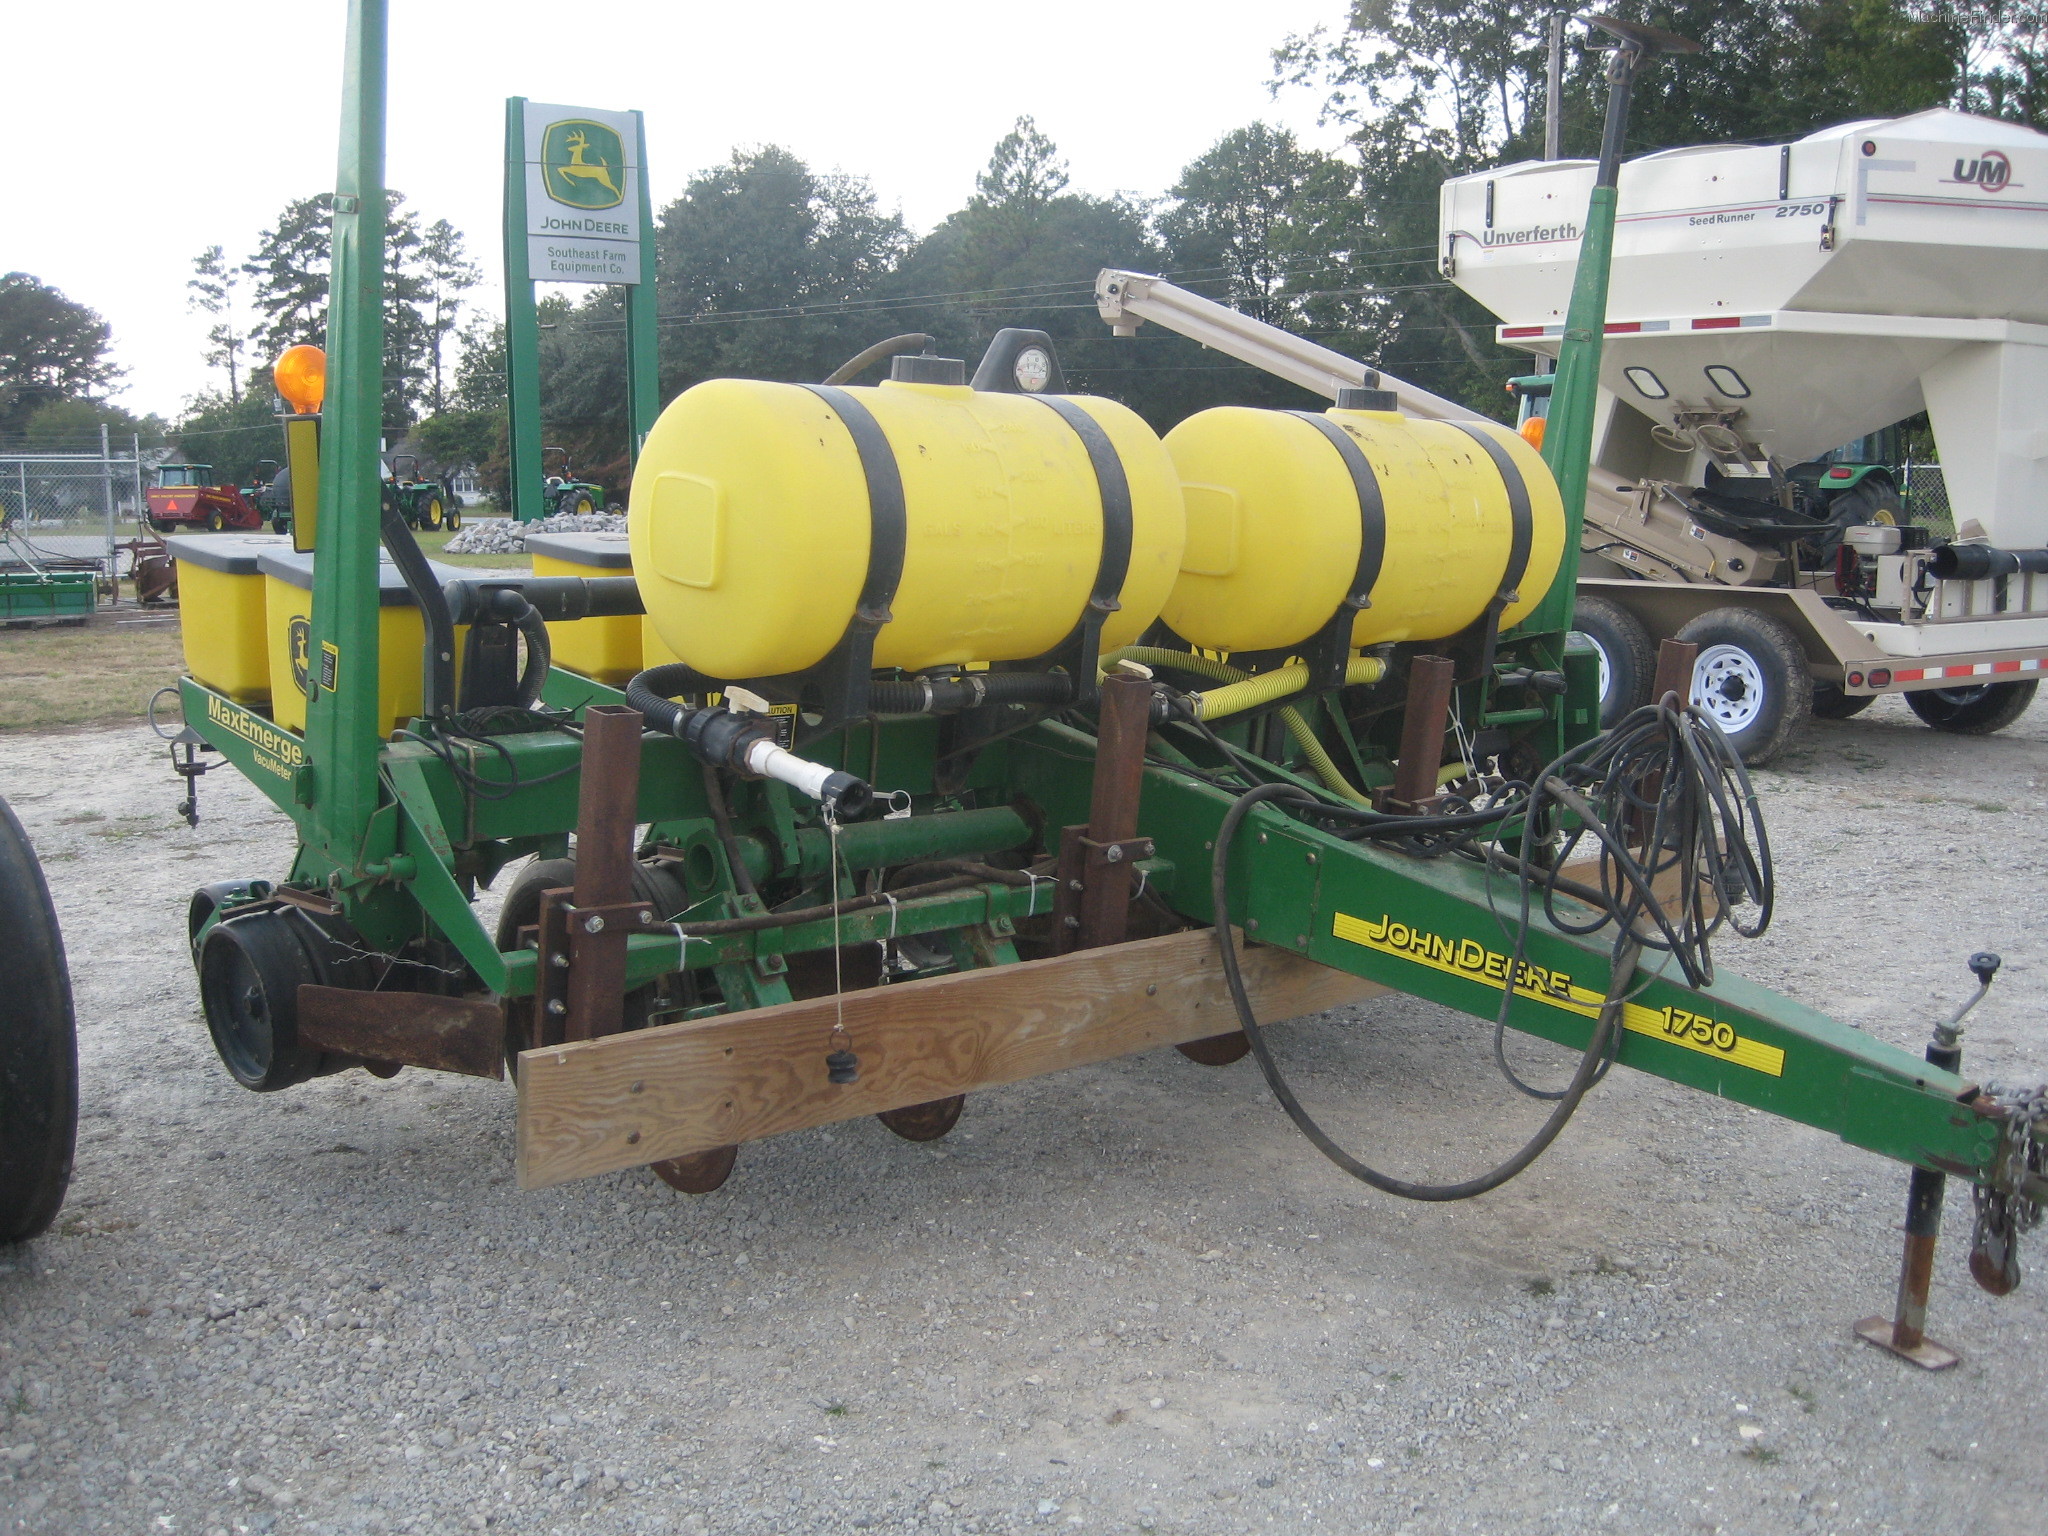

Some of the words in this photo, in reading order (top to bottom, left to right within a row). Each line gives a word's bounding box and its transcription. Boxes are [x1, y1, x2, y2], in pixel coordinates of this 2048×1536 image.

[1953, 158, 2007, 184] UM
[1775, 203, 1825, 218] 2750
[541, 216, 582, 230] JOHN
[584, 218, 628, 234] DEERE
[1483, 223, 1577, 245] Unverferth
[548, 247, 599, 260] Southeast
[603, 250, 626, 261] Farm
[551, 260, 606, 273] Equipment
[610, 264, 624, 274] Co.
[208, 694, 302, 764] MaxEmerge
[253, 748, 291, 781] VacuMeter
[1369, 914, 1455, 964] JOHN
[1661, 1005, 1736, 1052] 1750
